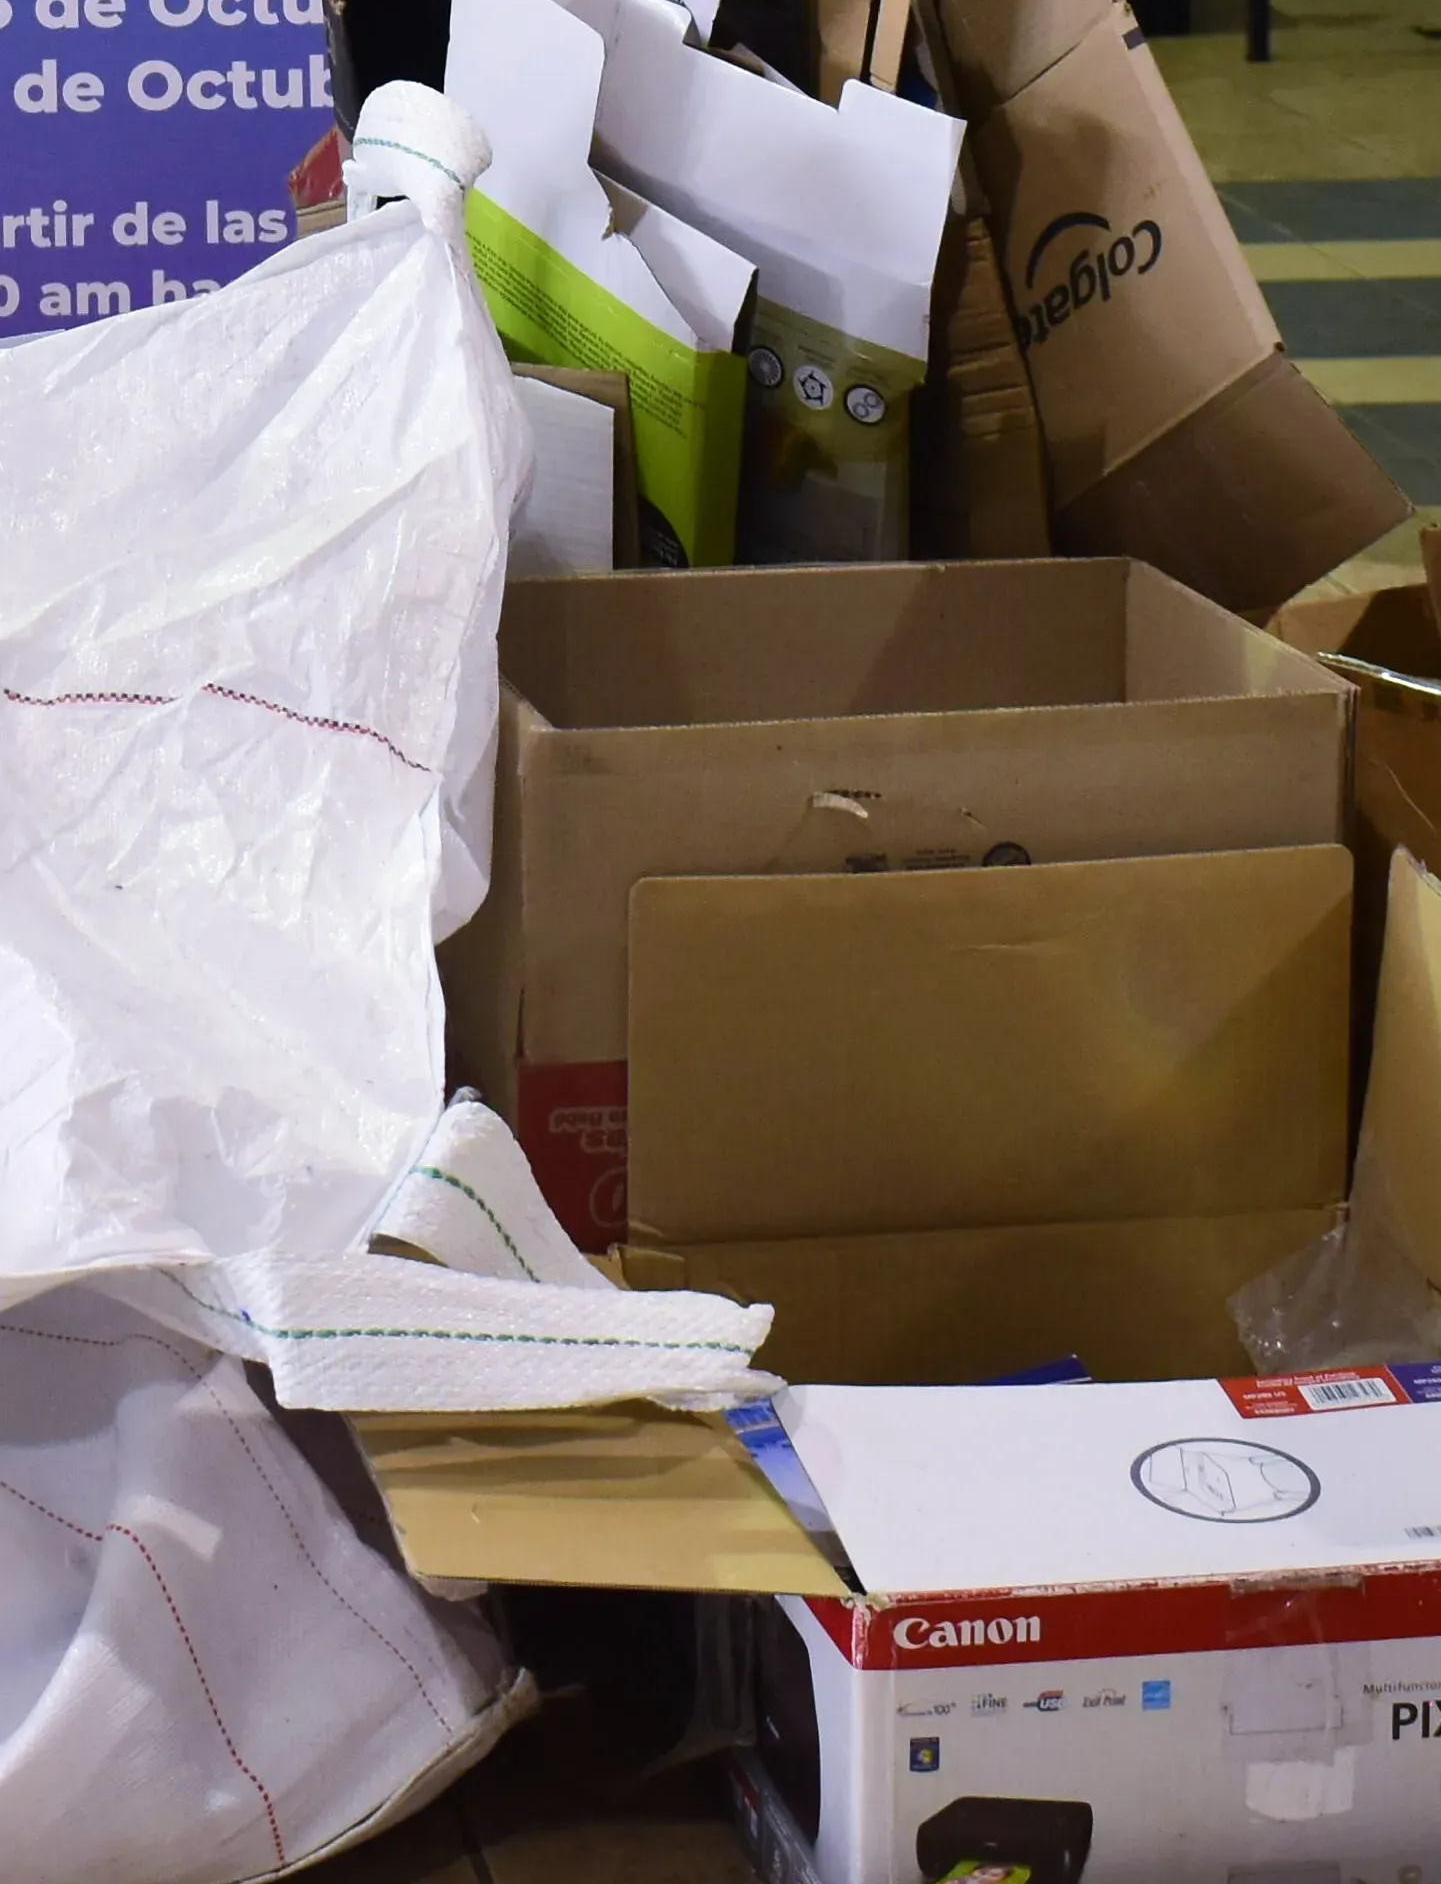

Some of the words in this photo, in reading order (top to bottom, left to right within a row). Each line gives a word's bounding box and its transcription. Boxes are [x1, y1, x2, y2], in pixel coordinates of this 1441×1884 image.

[12, 59, 105, 116] de
[112, 202, 187, 246] de
[205, 200, 288, 245] las
[40, 280, 131, 315] am
[893, 1614, 1041, 1650] Canon
